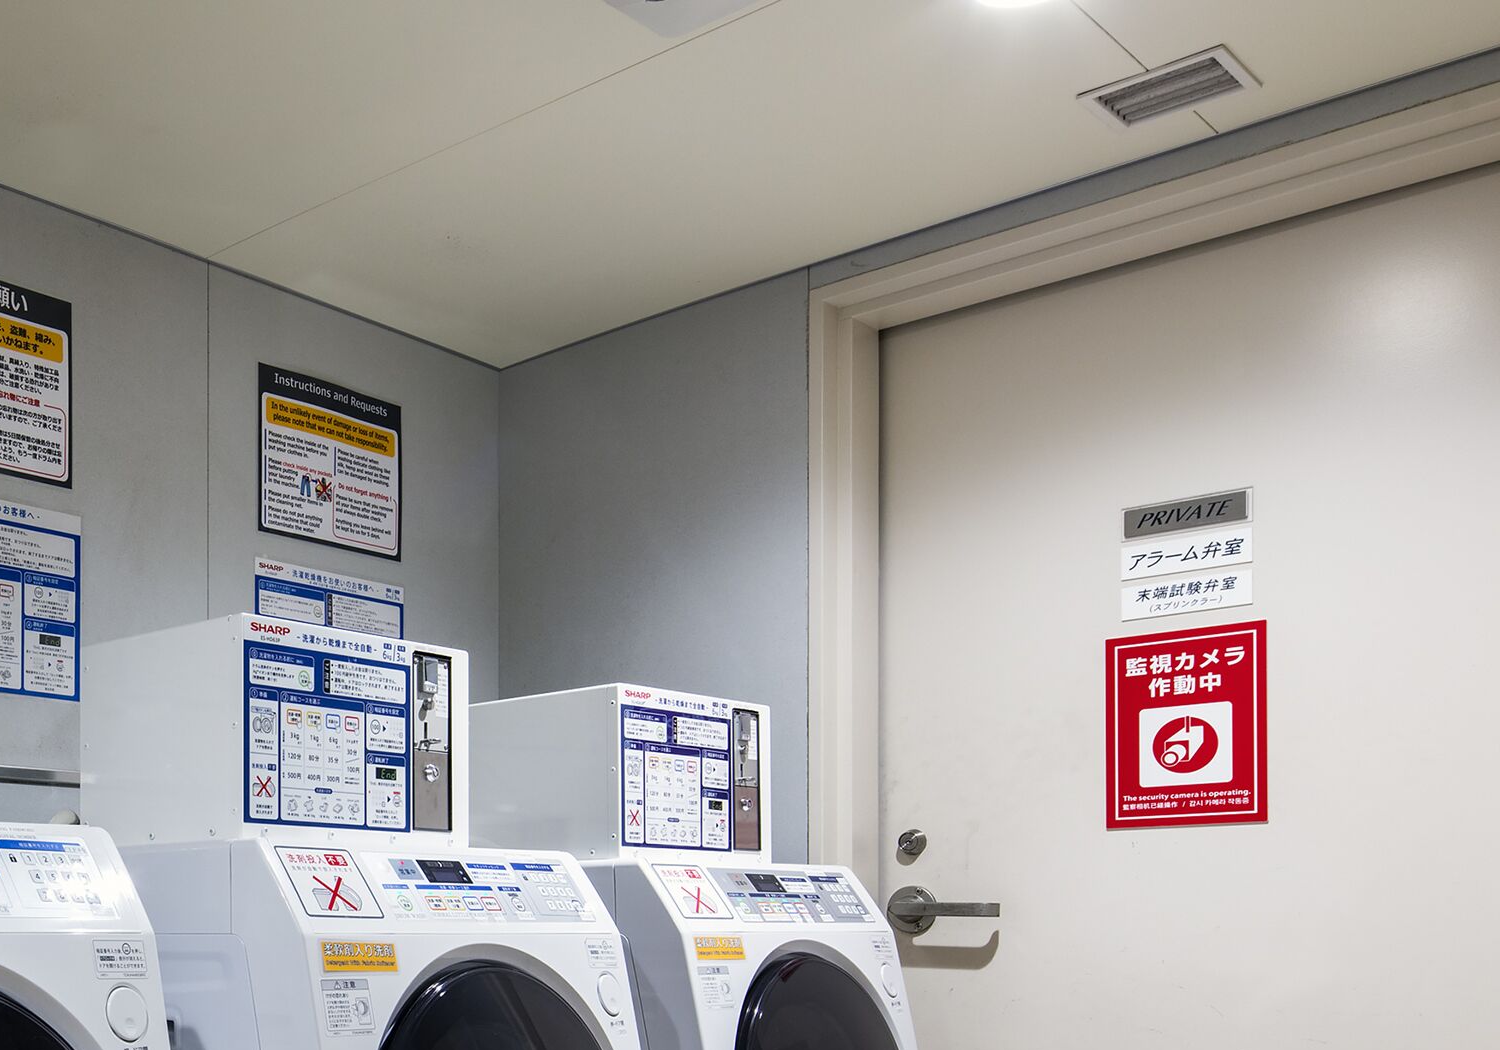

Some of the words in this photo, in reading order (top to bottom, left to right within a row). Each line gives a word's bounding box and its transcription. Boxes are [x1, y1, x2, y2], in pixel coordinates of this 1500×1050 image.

[275, 373, 331, 399] Instructions
[333, 392, 348, 403] and
[351, 396, 388, 416] Requests
[273, 413, 291, 424] please
[292, 418, 305, 427] note
[306, 422, 316, 430] that
[356, 437, 388, 452] responsibility.
[290, 406, 311, 418] unlikely
[312, 413, 326, 423] event
[333, 419, 351, 432] damage
[359, 427, 368, 436] loss
[1137, 499, 1233, 529] PRIVATE
[259, 562, 283, 572] SHARP
[1129, 538, 1244, 571] アラーム弁室
[1136, 576, 1237, 602] 末端試験弁室
[250, 622, 290, 636] SHARP
[1125, 646, 1245, 677] 監視カメラ
[625, 690, 651, 699] SHARP
[1149, 672, 1222, 697] 作動中
[1139, 793, 1169, 802] security
[1209, 789, 1251, 798] operating.
[324, 943, 394, 958] 柔軟剤入り洗剤
